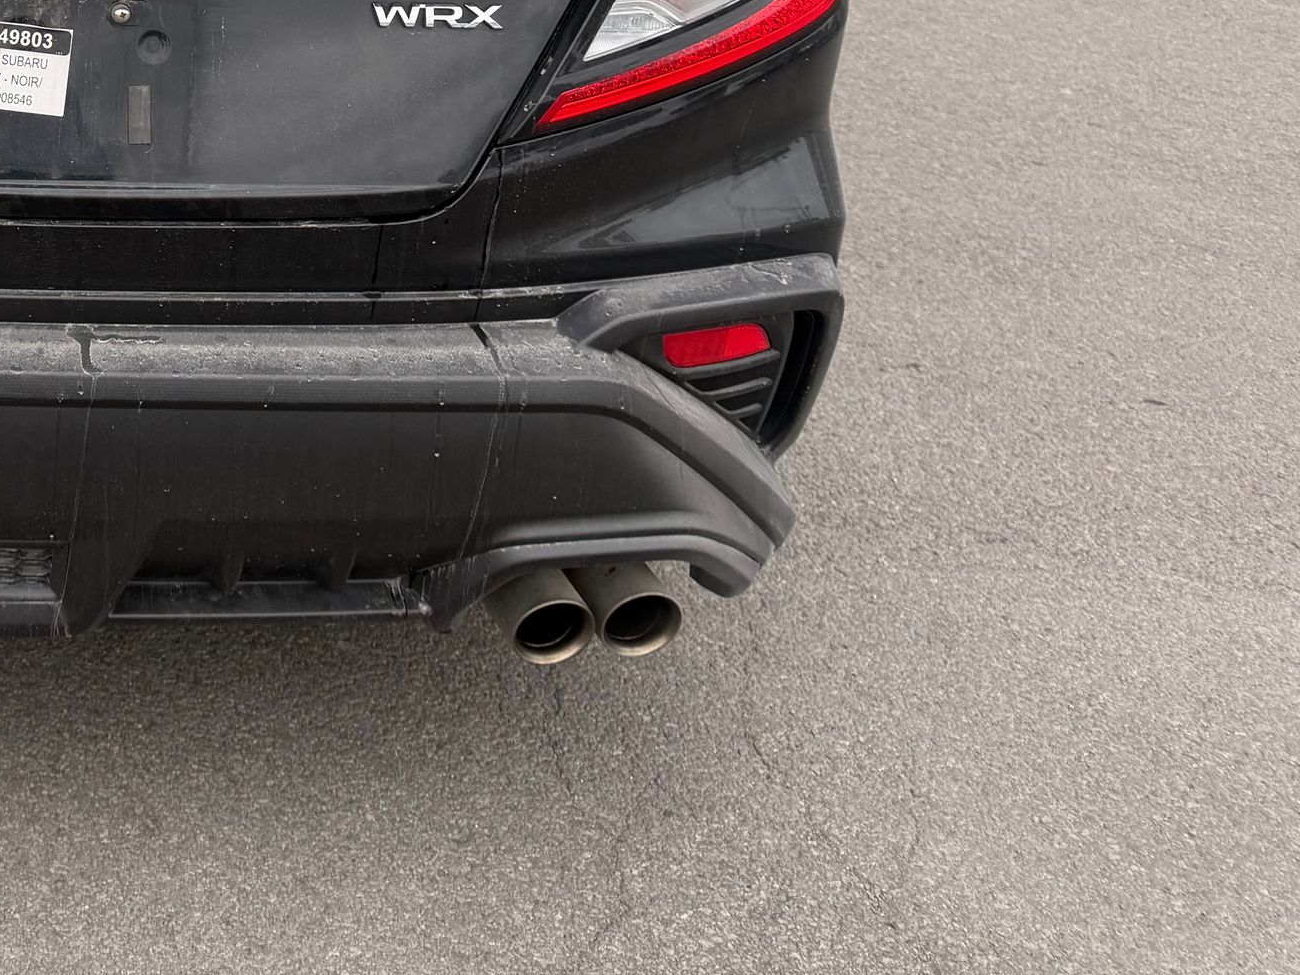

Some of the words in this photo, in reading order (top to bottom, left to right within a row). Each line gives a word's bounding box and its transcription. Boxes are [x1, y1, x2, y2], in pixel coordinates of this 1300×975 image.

[372, 2, 503, 29] WRX
[1, 54, 49, 70] SUBARU
[10, 74, 44, 88] NOIR/
